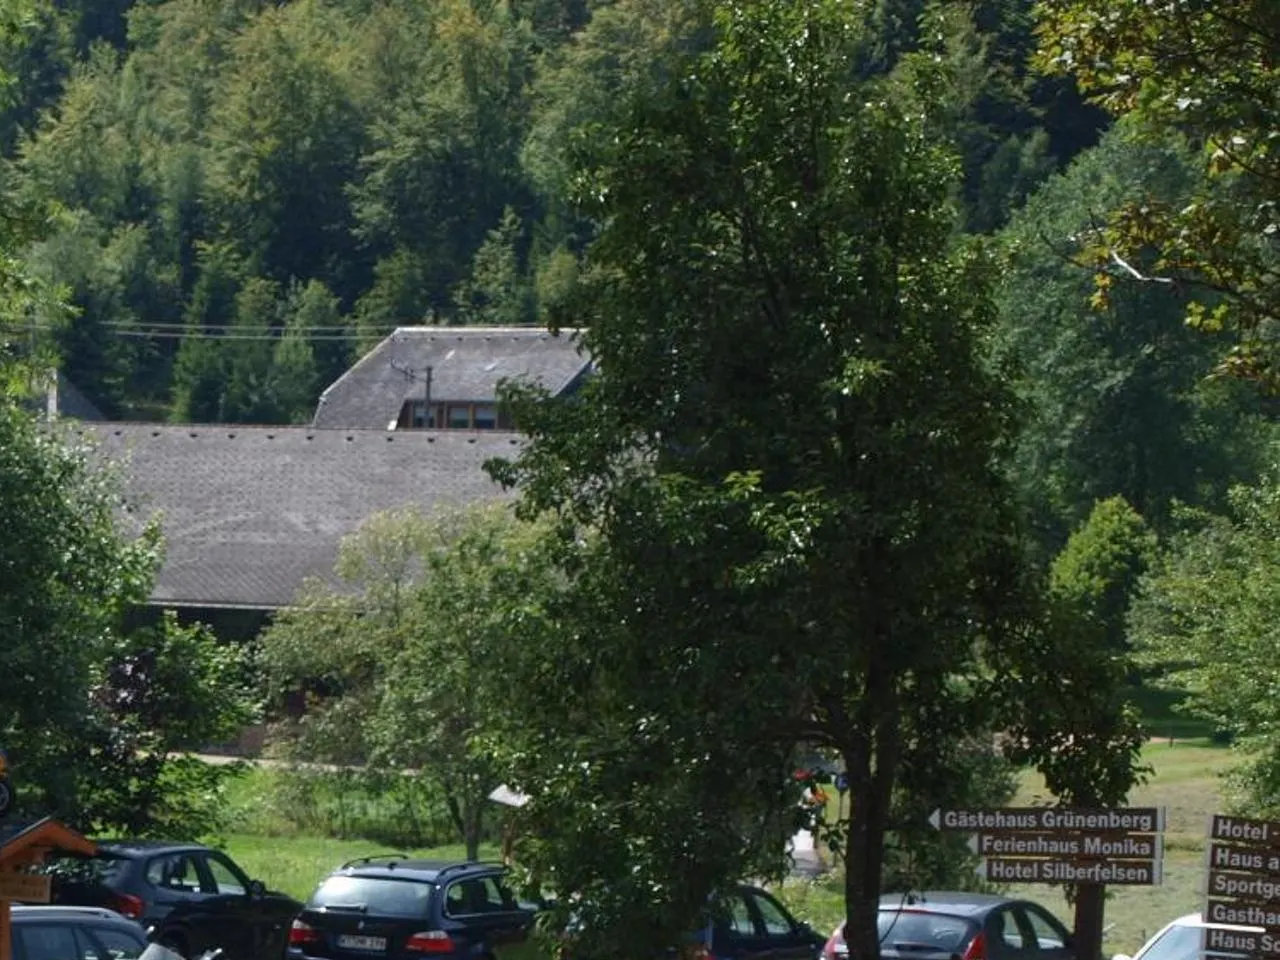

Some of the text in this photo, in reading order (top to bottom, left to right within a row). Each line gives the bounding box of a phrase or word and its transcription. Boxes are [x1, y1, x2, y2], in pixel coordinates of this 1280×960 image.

[944, 810, 1152, 830] Gästehaus Grünenberg
[1218, 818, 1268, 841] Hotel
[982, 835, 1151, 855] Ferienhaus Monika
[1216, 847, 1263, 868] Haus
[991, 861, 1148, 881] Hotel Silberfelsen
[1210, 931, 1256, 950] Haus
